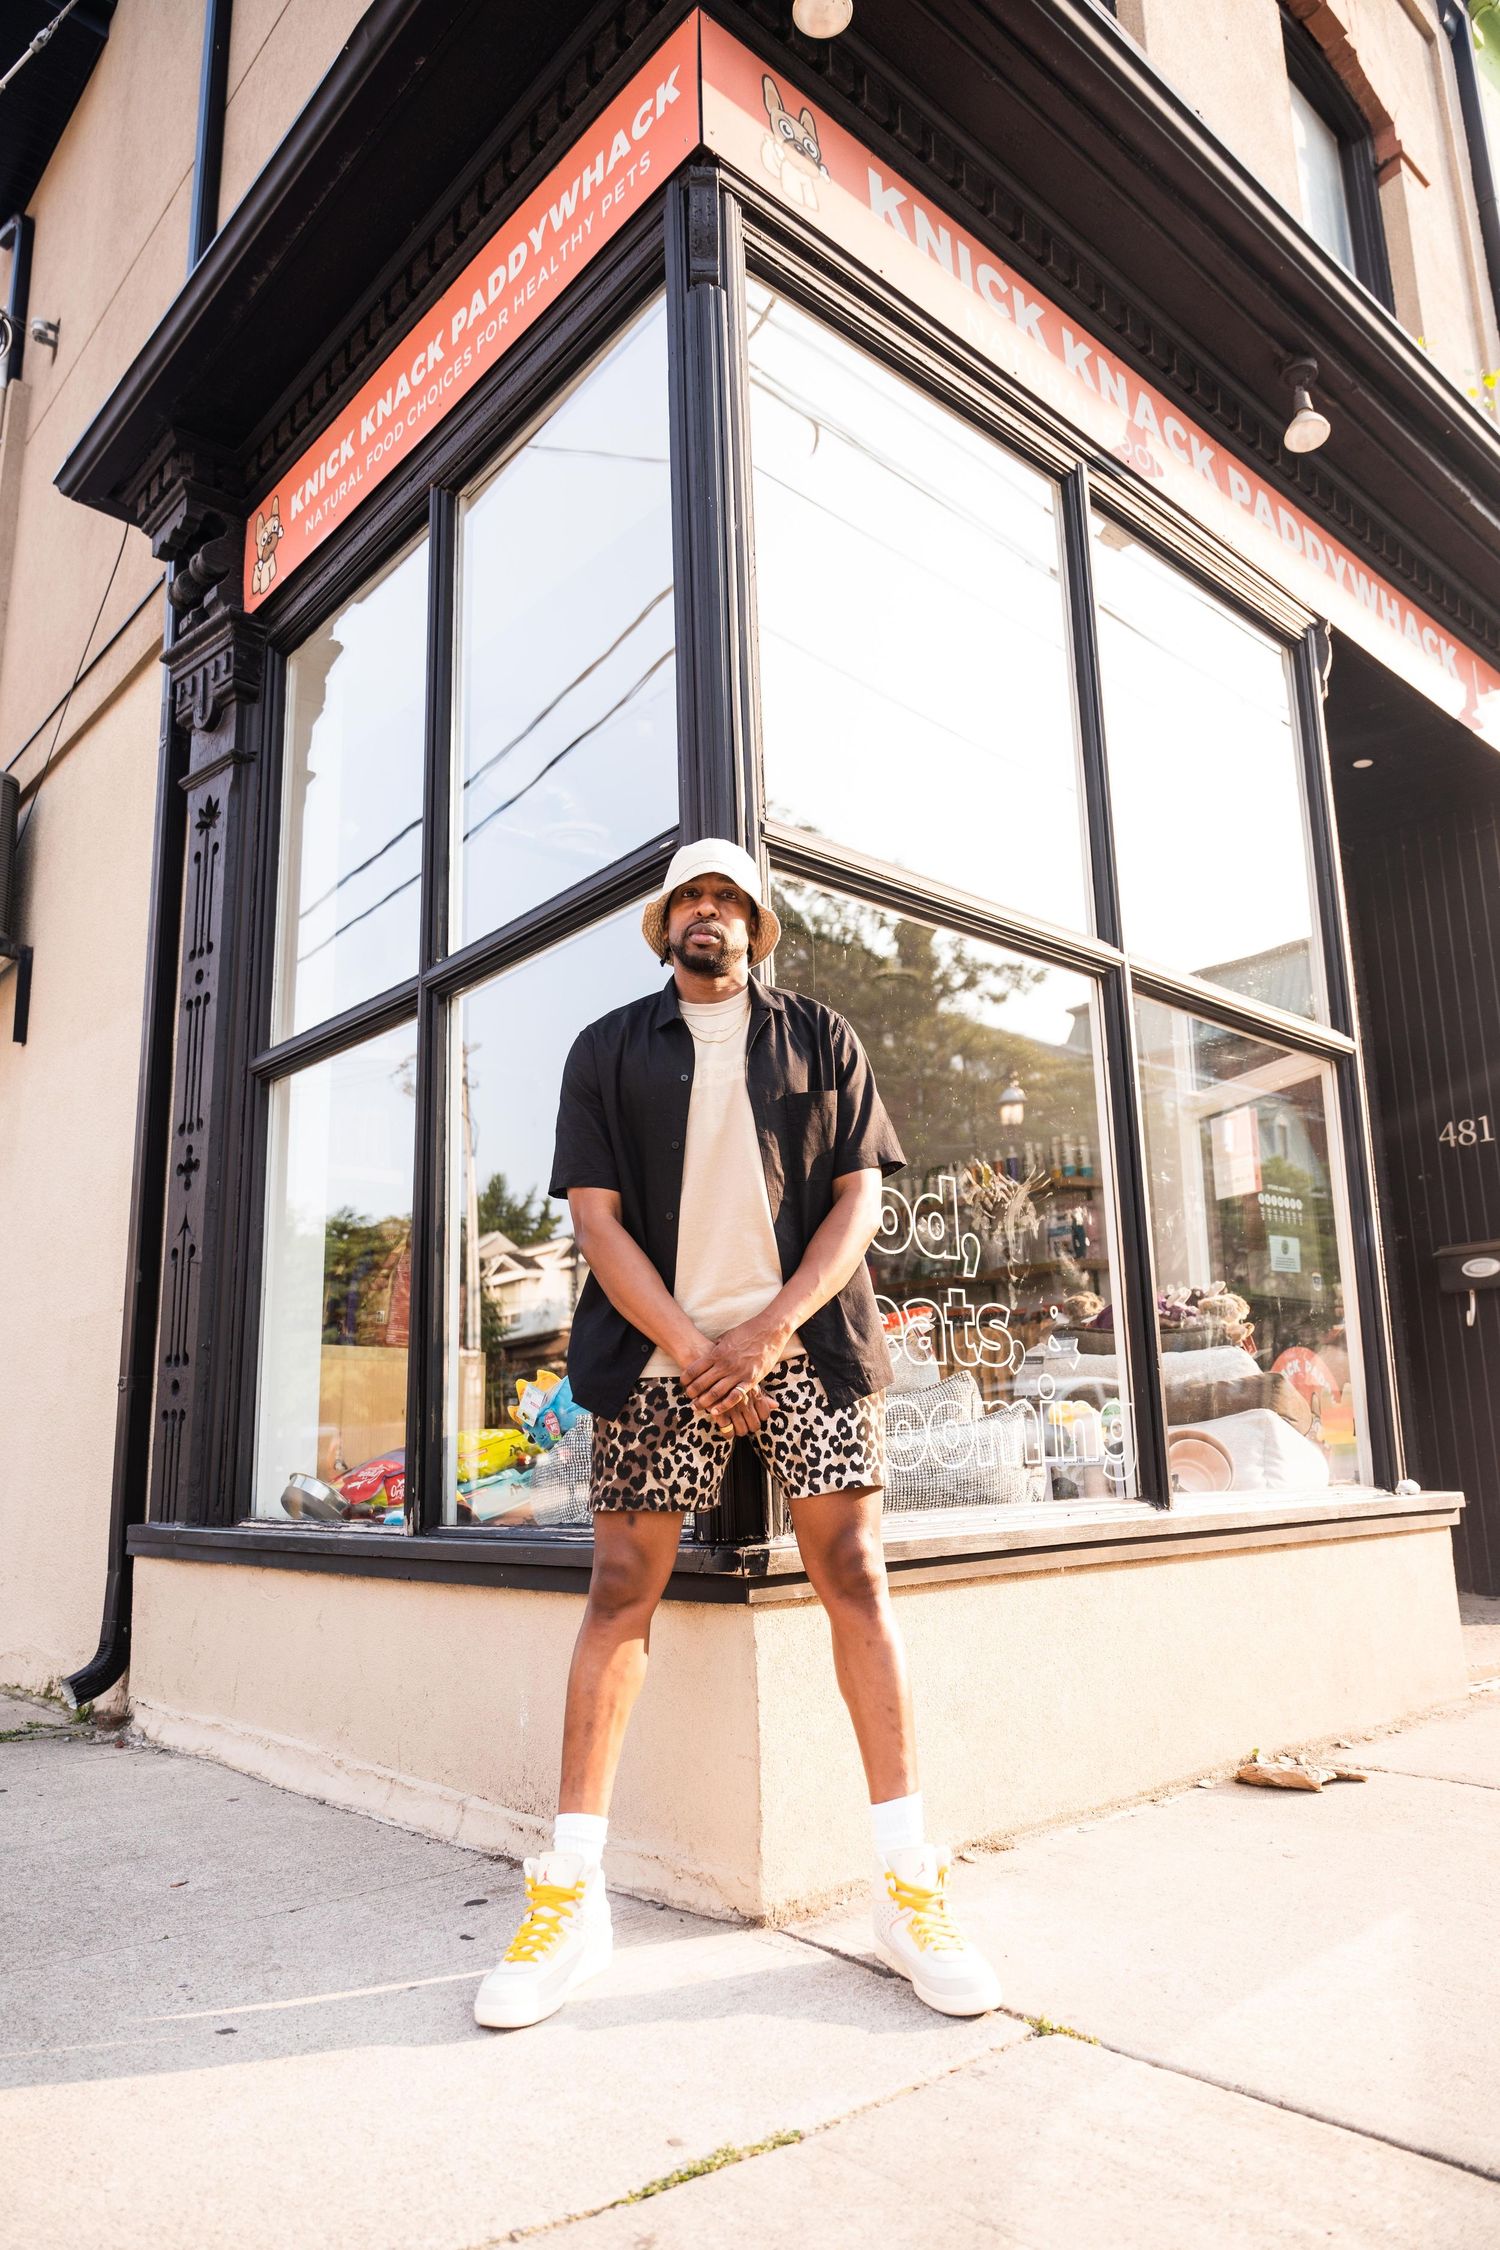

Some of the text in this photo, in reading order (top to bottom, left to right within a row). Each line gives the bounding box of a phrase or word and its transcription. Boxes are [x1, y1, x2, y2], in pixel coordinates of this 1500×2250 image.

[290, 64, 681, 522] KNICK KNACK PADDYWHACK
[305, 151, 651, 536] NATURAL FOOD CHOICES FOR HEALTHY PETS
[868, 167, 1049, 352] KNICK
[1062, 326, 1220, 493] KNACK
[1227, 465, 1460, 678] PADDYWHACK
[1438, 1115, 1496, 1148] 481
